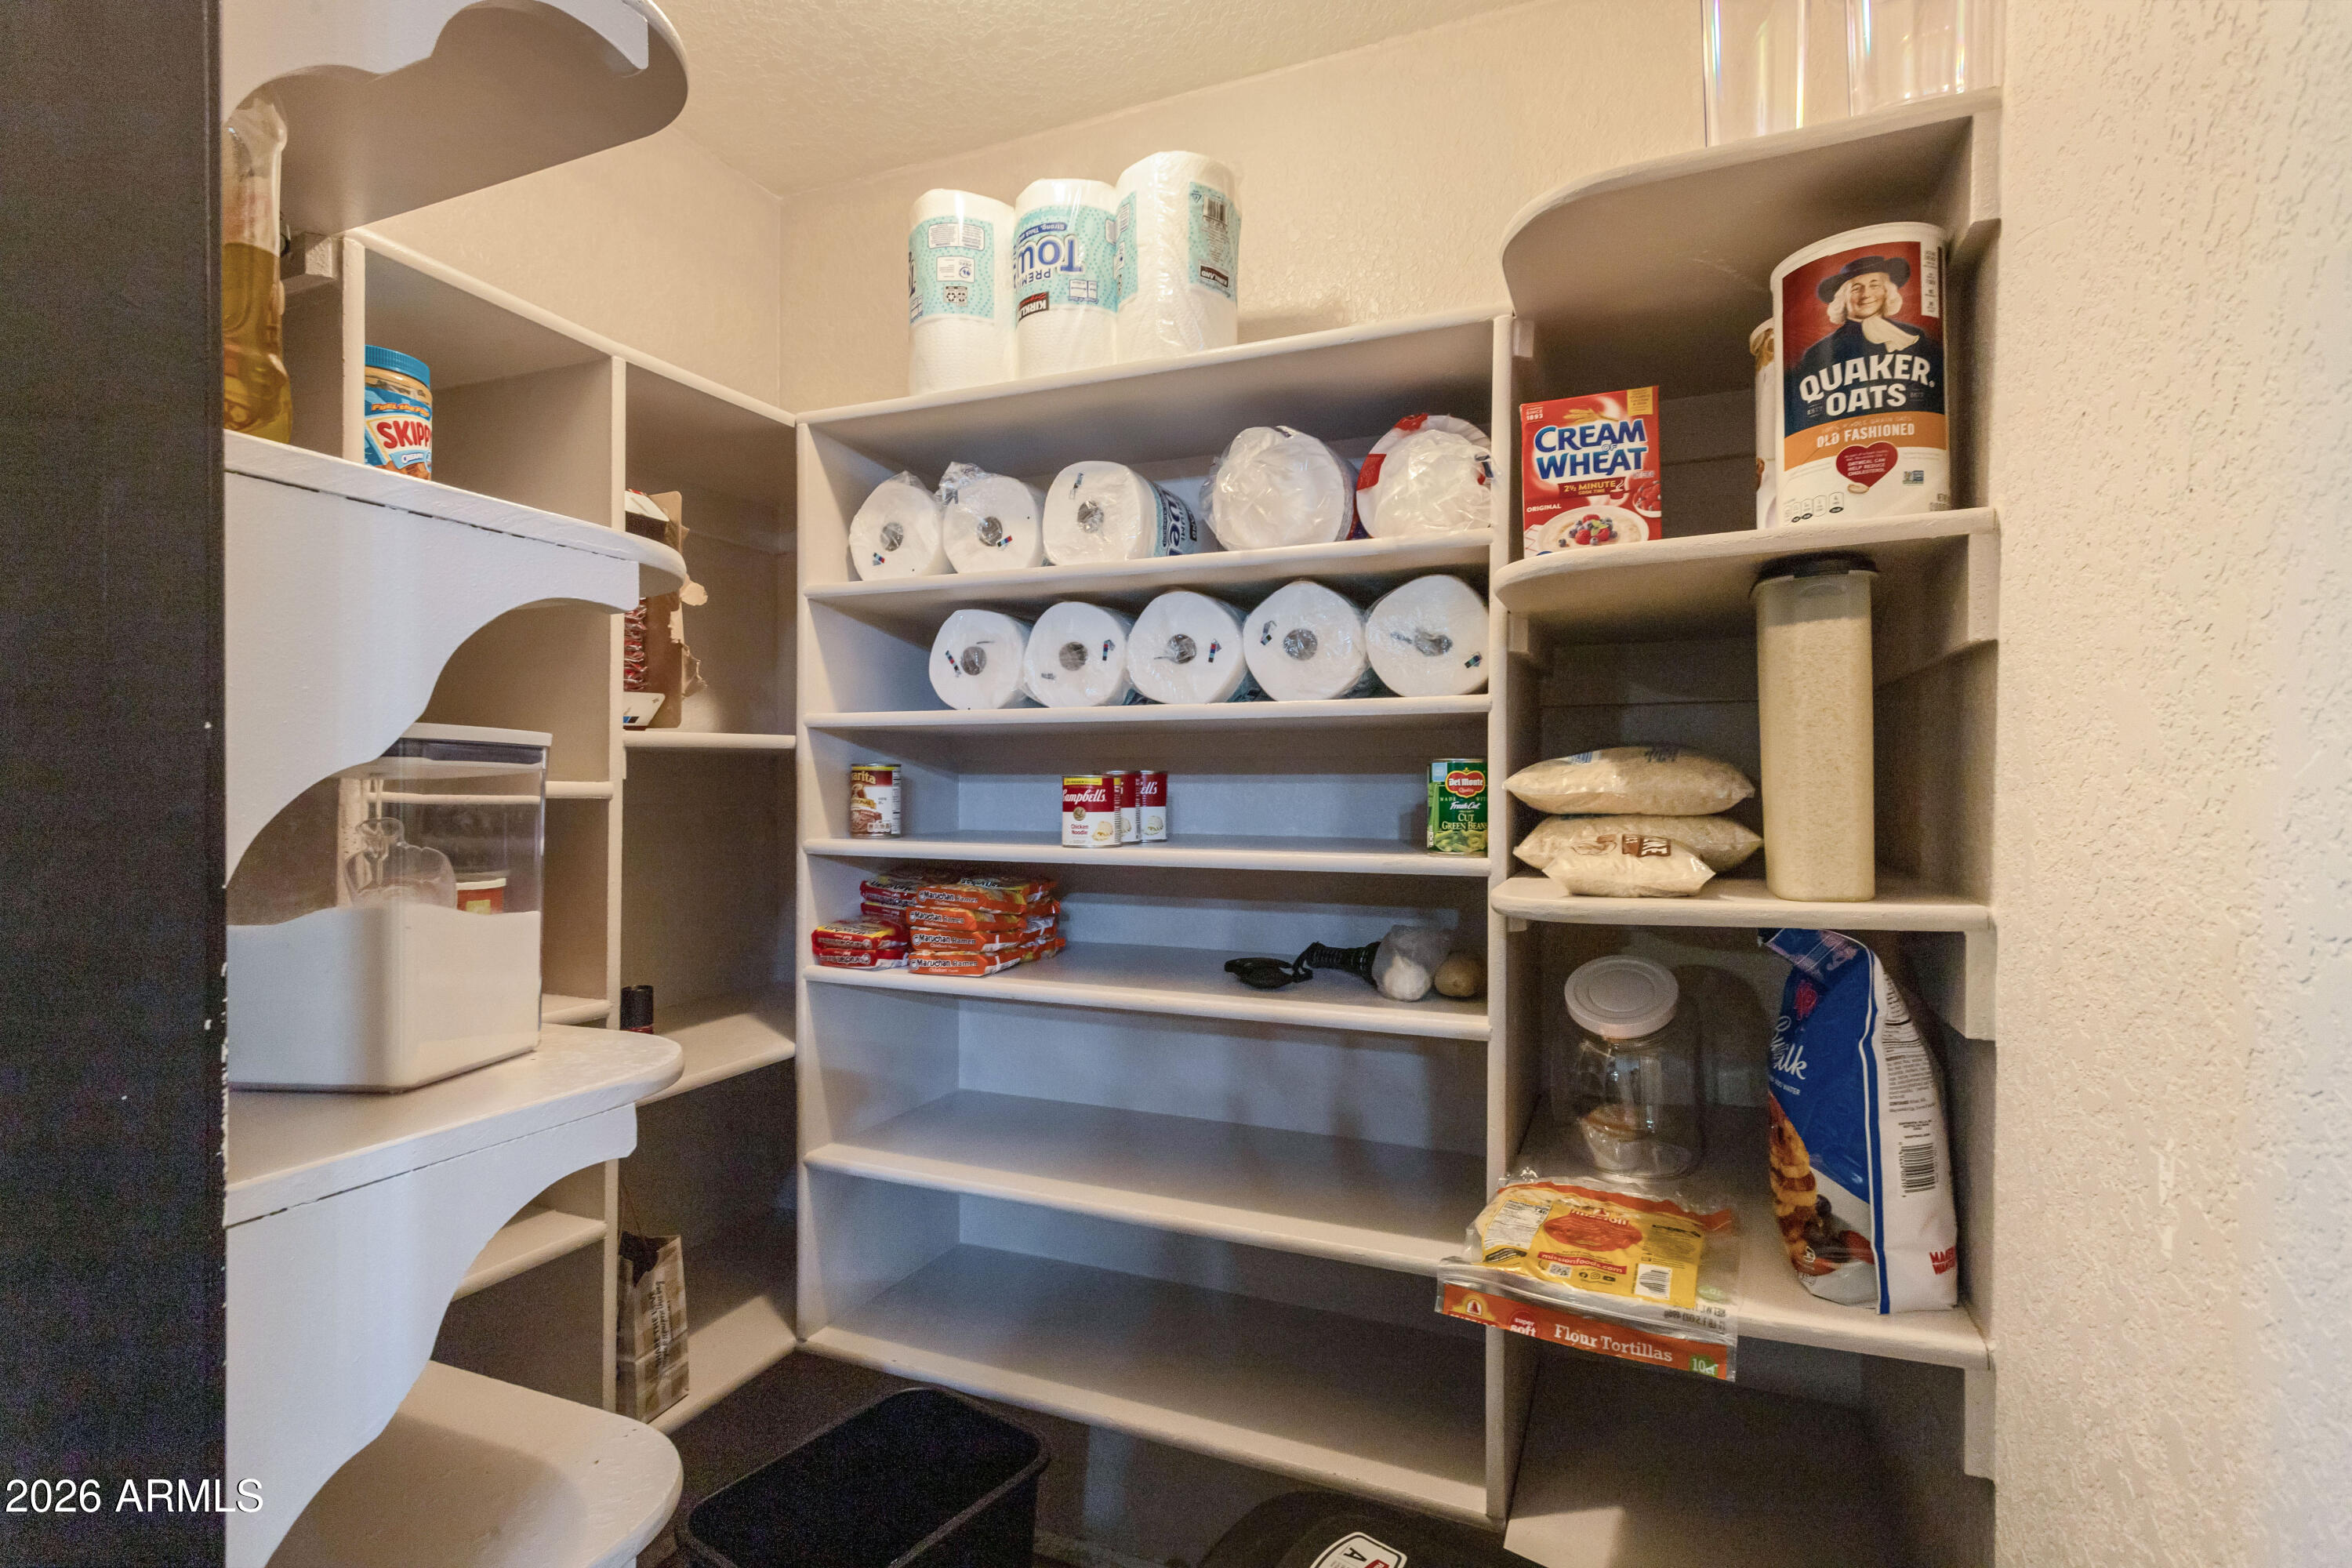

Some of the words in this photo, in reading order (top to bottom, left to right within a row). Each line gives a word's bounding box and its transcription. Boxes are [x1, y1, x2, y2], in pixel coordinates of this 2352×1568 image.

[1798, 354, 1931, 404] QUAKER
[1826, 383, 1907, 416] OATS
[376, 420, 432, 449] SKIPP
[1535, 419, 1646, 453] CREAM
[1817, 433, 1839, 448] OLD
[1844, 423, 1915, 443] FASHIONED
[1602, 444, 1617, 452] OF
[1536, 447, 1647, 480] WHEAT
[1578, 480, 1617, 492] MINUTE
[1526, 503, 1562, 513] ORIGINAL
[1448, 778, 1461, 786] Del
[1457, 813, 1475, 822] CUT
[1441, 821, 1466, 830] GREEN
[924, 891, 954, 901] Maruchan
[915, 912, 942, 922] Maruchan
[919, 935, 950, 943] Maruchan
[1541, 1254, 1623, 1273] missionfoods.com
[1515, 1317, 1536, 1327] super
[1510, 1324, 1537, 1338] soft
[1553, 1323, 1599, 1348] Flour
[1600, 1335, 1673, 1363] Tortillas
